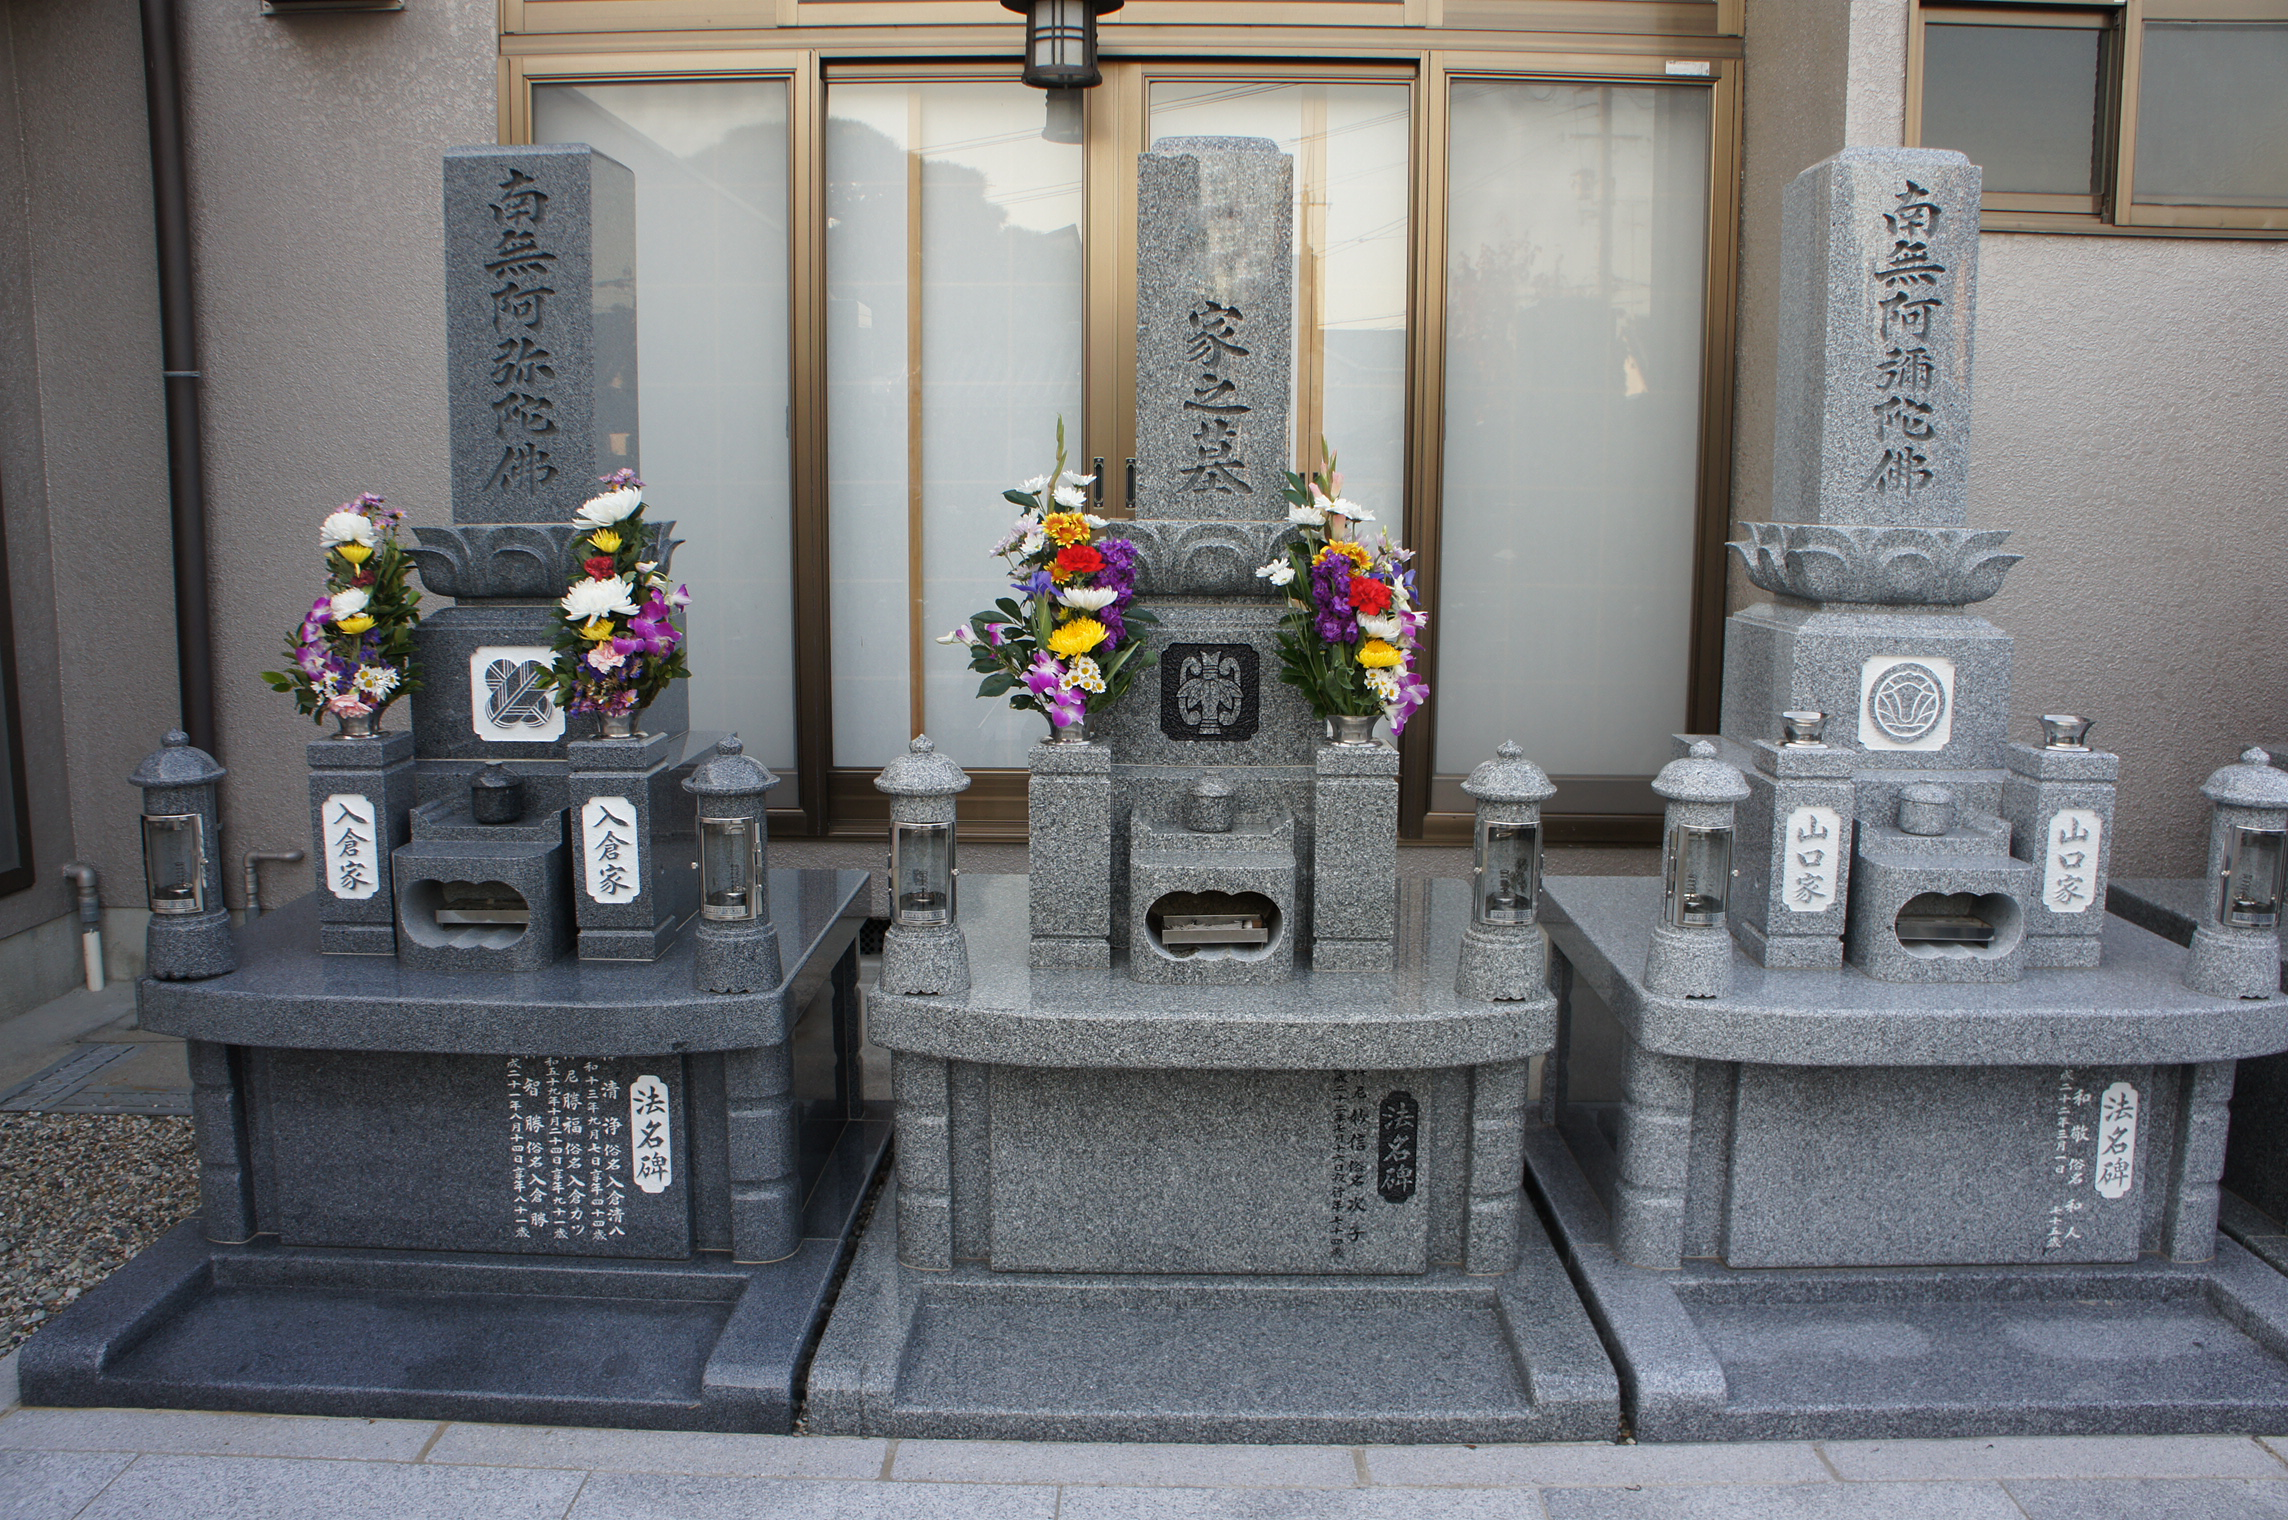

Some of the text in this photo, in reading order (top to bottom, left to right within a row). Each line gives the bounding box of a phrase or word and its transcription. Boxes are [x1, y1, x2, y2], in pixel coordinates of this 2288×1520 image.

[484, 167, 558, 496] 南無阿弥陀佛
[1176, 300, 1252, 494] 家之墓
[333, 802, 375, 890] 入倉家
[593, 805, 632, 894] 入倉家
[1795, 814, 1829, 904] 山口家
[2053, 816, 2089, 905] 山口家
[632, 1085, 669, 1183] 法名碑
[1380, 1101, 1415, 1193] 法名碑
[2097, 1091, 2134, 1188] 法名碑
